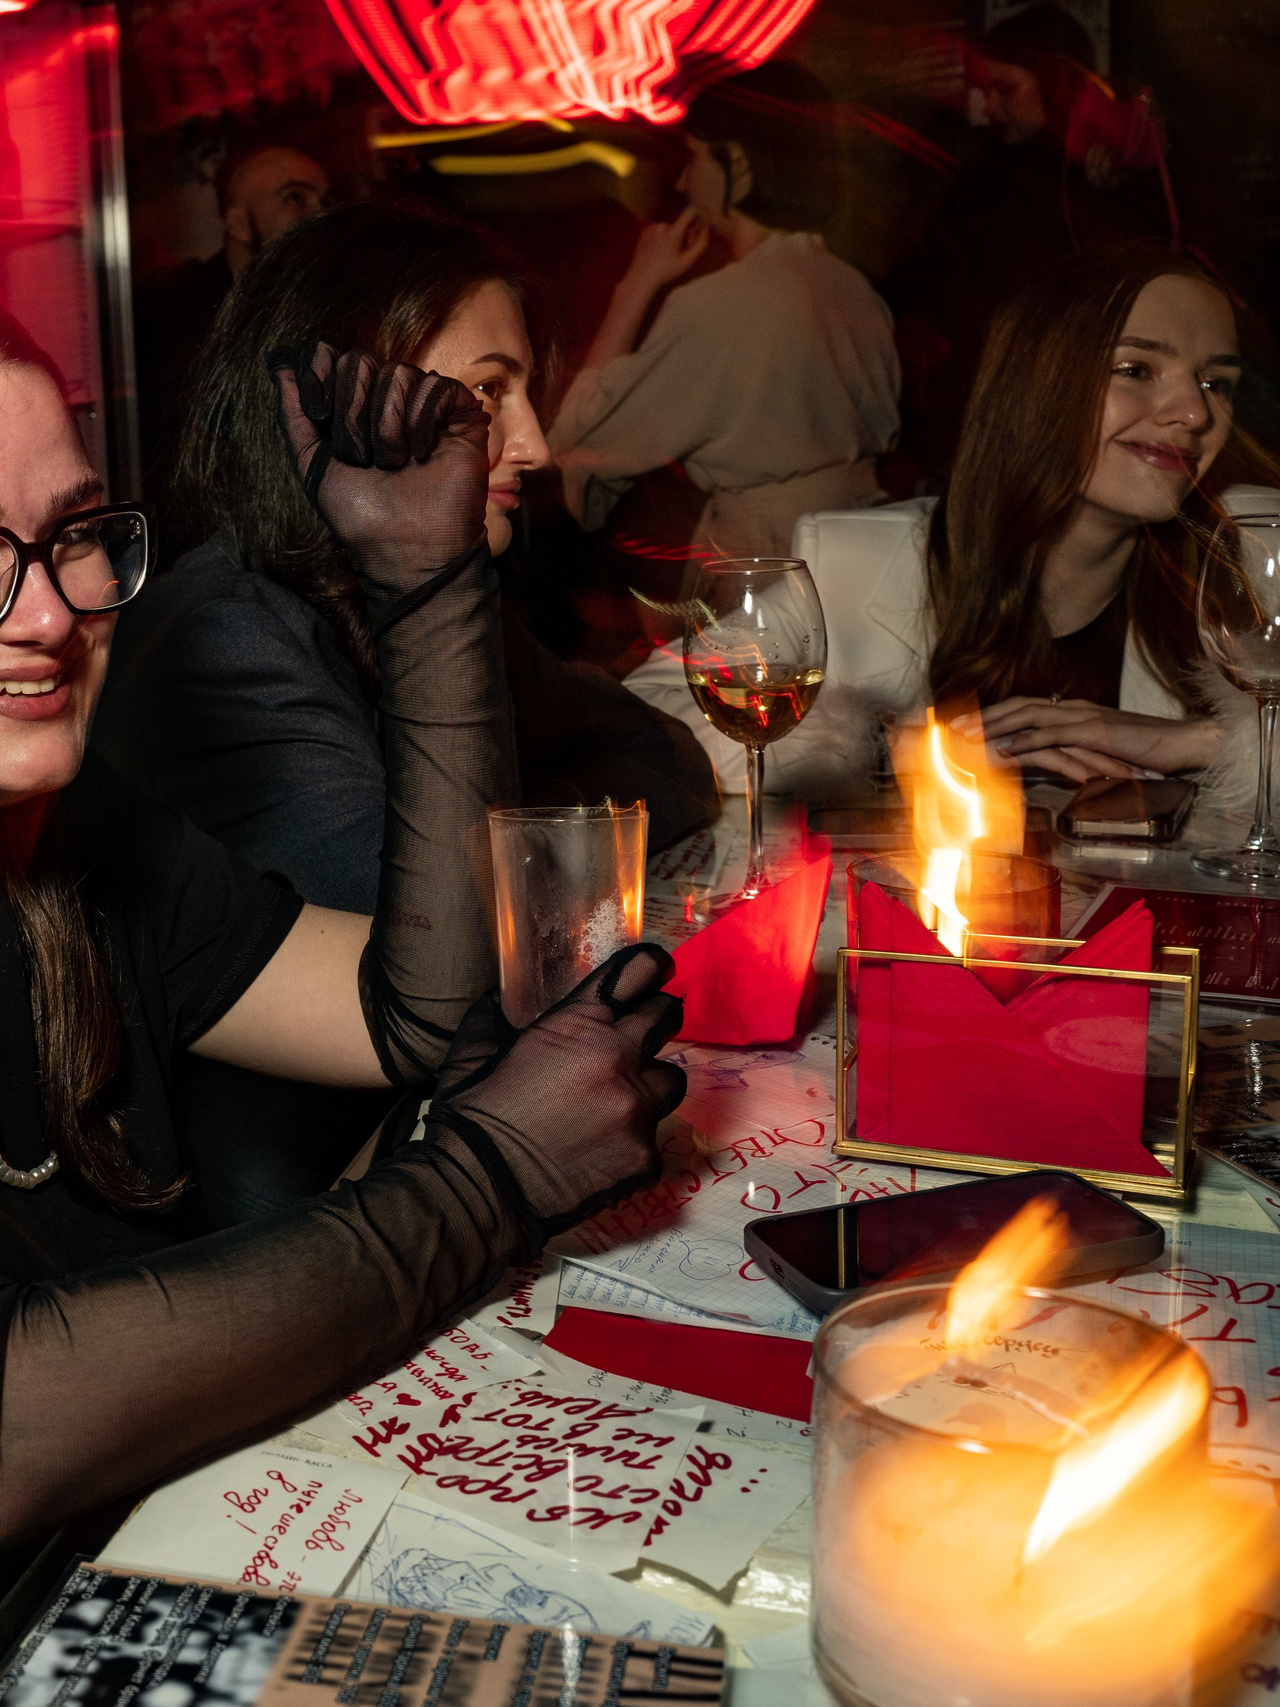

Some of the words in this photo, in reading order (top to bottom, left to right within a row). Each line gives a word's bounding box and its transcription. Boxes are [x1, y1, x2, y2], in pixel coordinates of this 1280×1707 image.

[471, 1408, 555, 1431] тот
[237, 1480, 323, 1586] путешествова
[305, 1488, 363, 1551] Любовь
